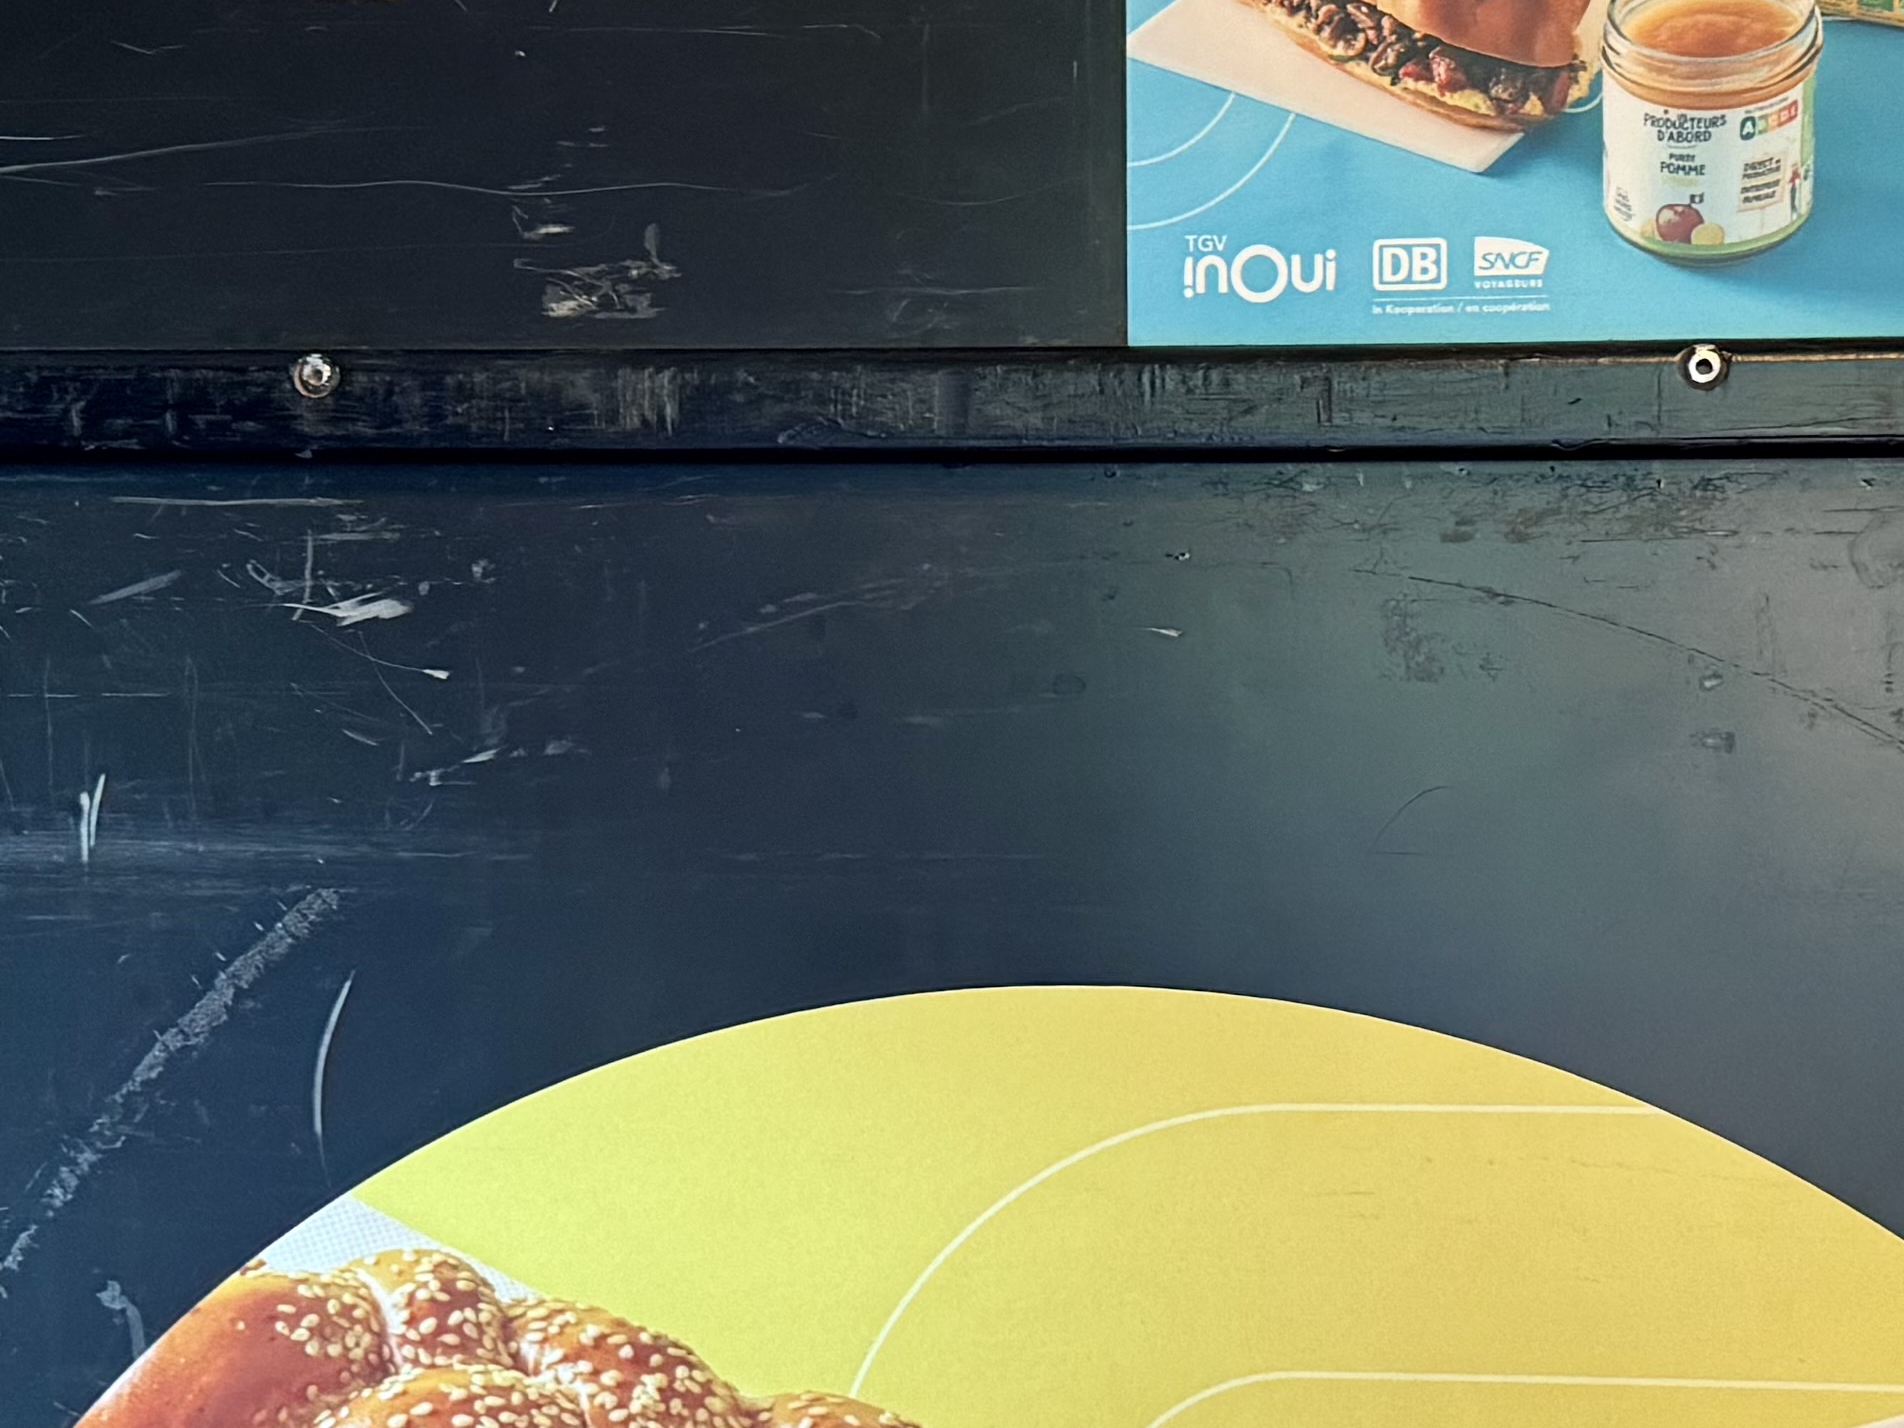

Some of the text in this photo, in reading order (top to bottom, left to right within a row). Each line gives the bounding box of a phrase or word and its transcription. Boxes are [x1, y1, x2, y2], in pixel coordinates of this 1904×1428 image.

[1184, 234, 1228, 253] TGV
[1381, 246, 1439, 282] DB
[1477, 250, 1543, 272] SNCF
